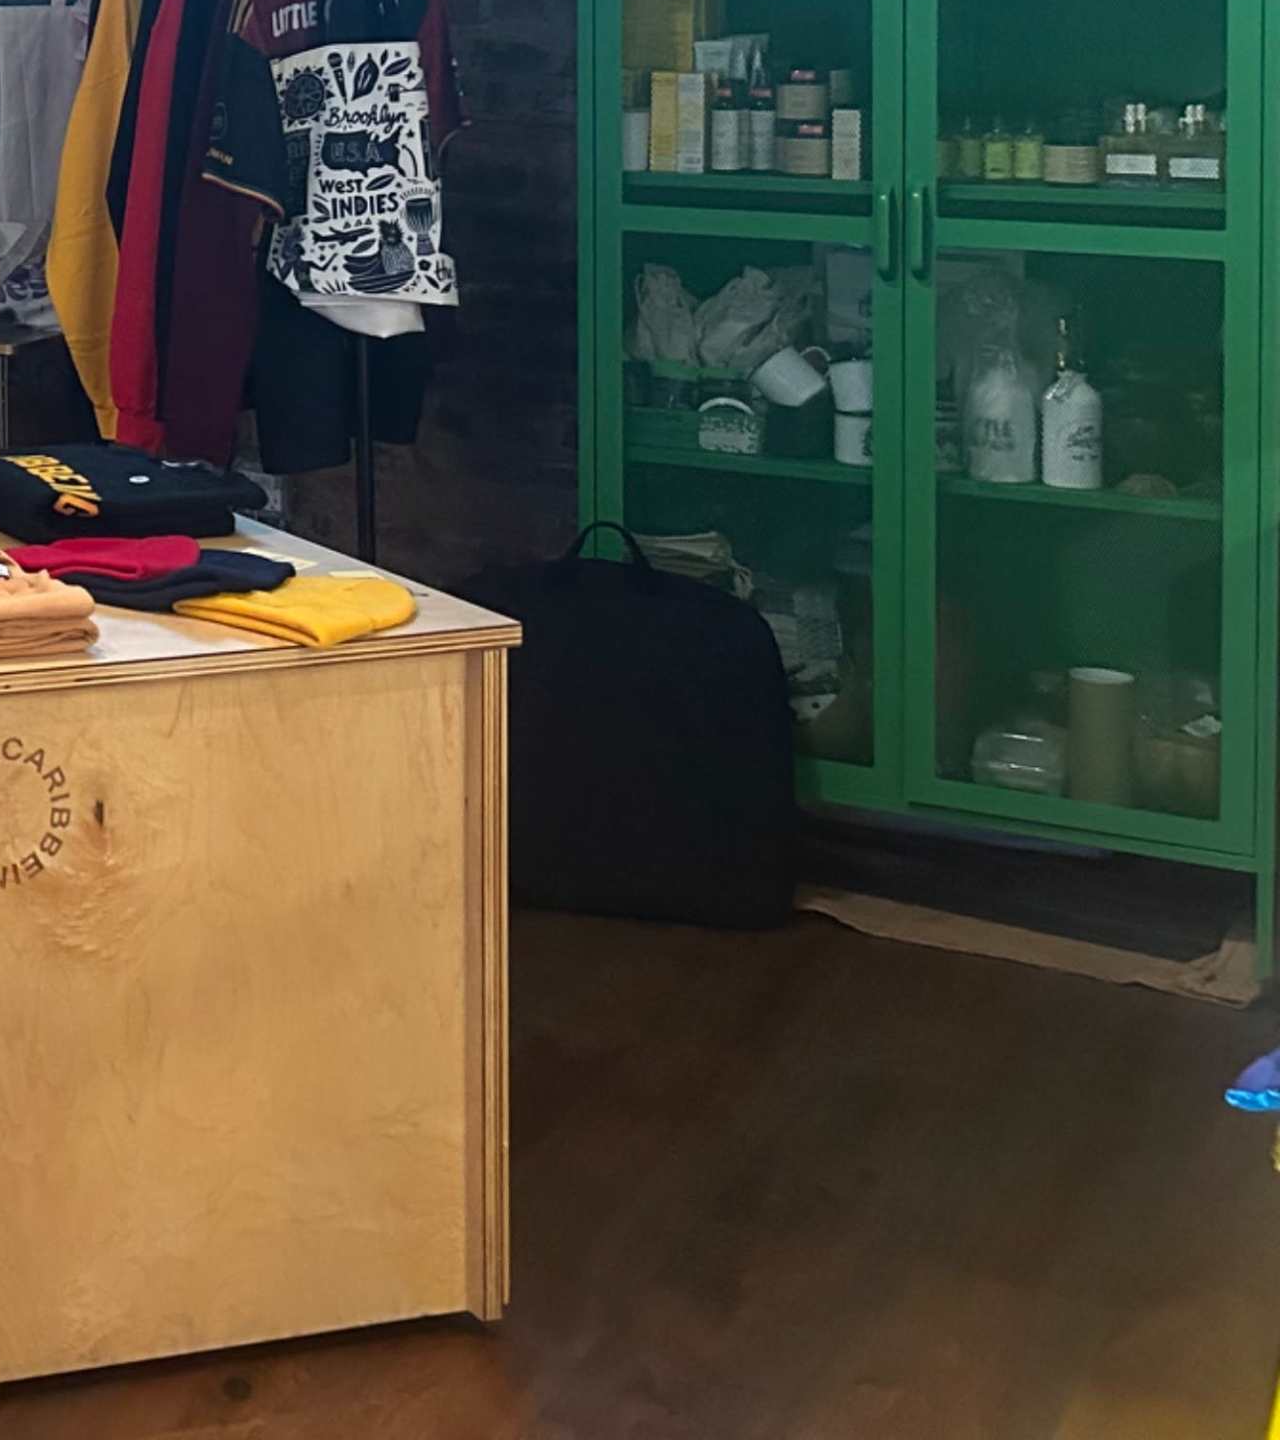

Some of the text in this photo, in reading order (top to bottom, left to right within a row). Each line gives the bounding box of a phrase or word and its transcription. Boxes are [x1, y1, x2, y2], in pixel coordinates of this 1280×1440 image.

[272, 1, 317, 37] LITTLE
[325, 104, 409, 133] Brooklyn
[331, 192, 400, 220] INDIES
